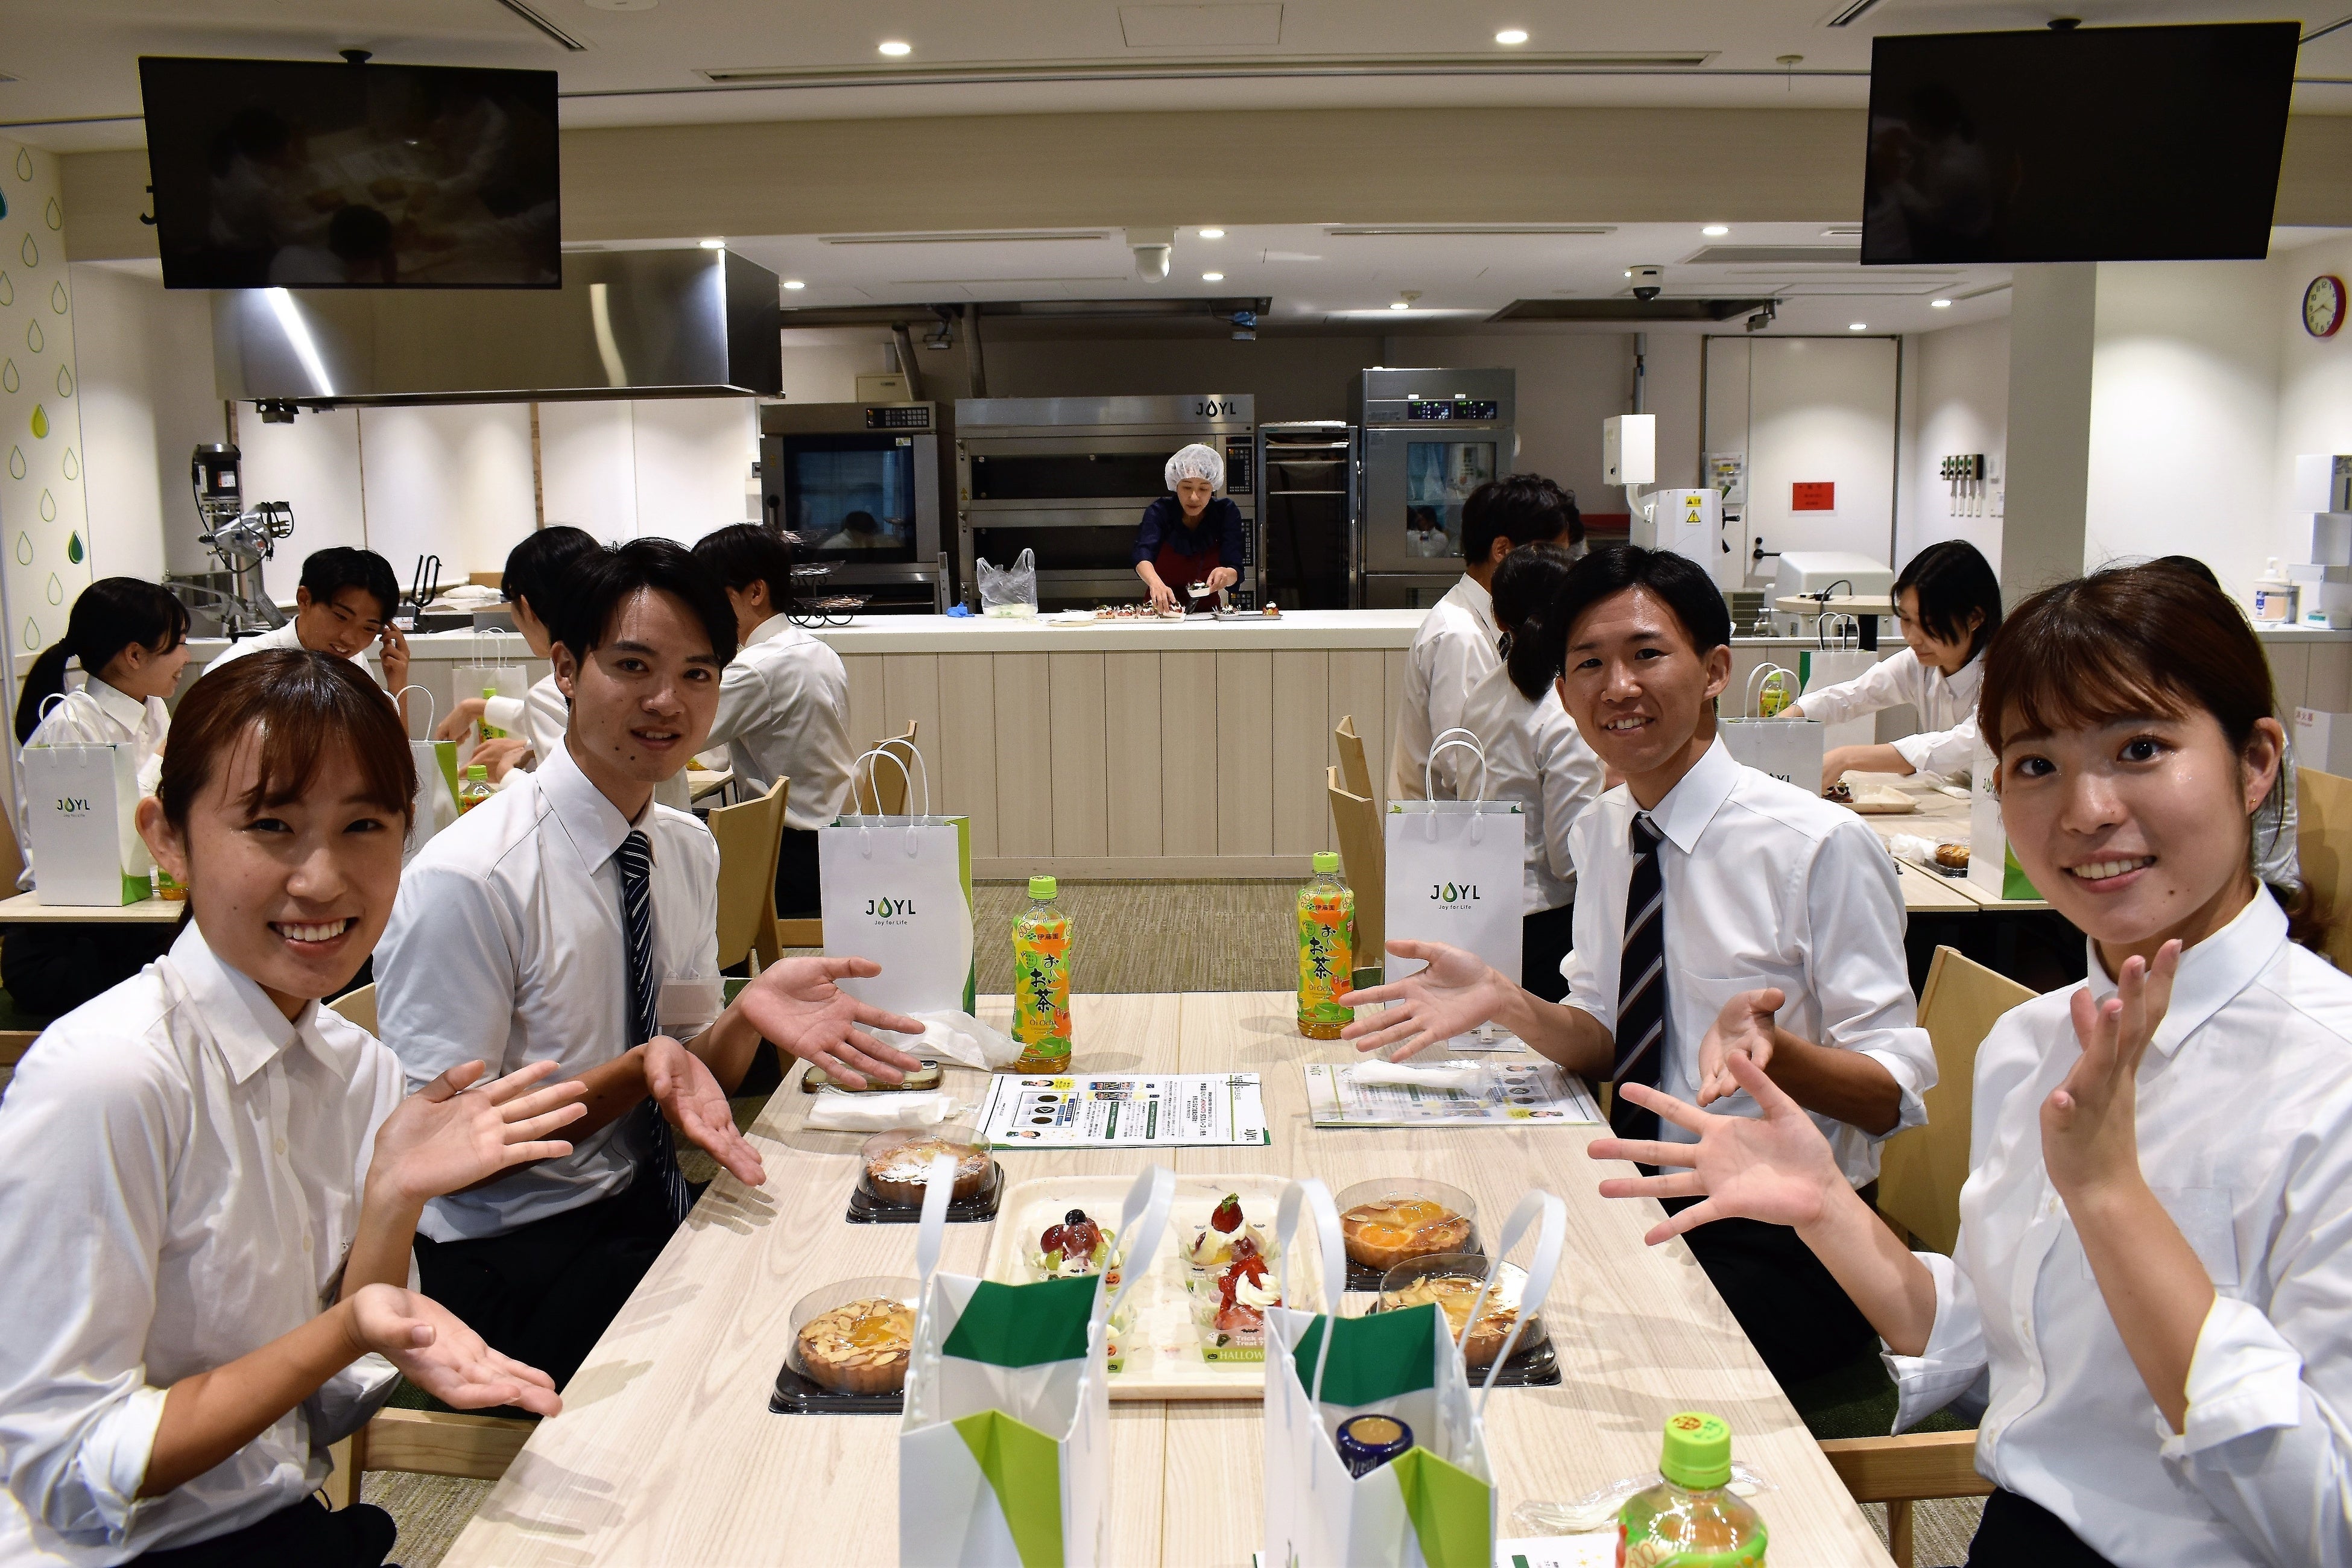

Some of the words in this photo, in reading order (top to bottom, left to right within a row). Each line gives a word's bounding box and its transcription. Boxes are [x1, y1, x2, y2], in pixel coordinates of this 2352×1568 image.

[1196, 400, 1236, 417] JOYL
[57, 797, 90, 812] JOYL
[1430, 881, 1481, 903] JOYL
[865, 896, 916, 918] JOYL
[1309, 936, 1334, 979] お茶
[1030, 967, 1056, 1013] お茶
[1234, 1075, 1244, 1089] NES
[1244, 1129, 1258, 1141] JOYL
[1219, 1351, 1265, 1360] HALLOW
